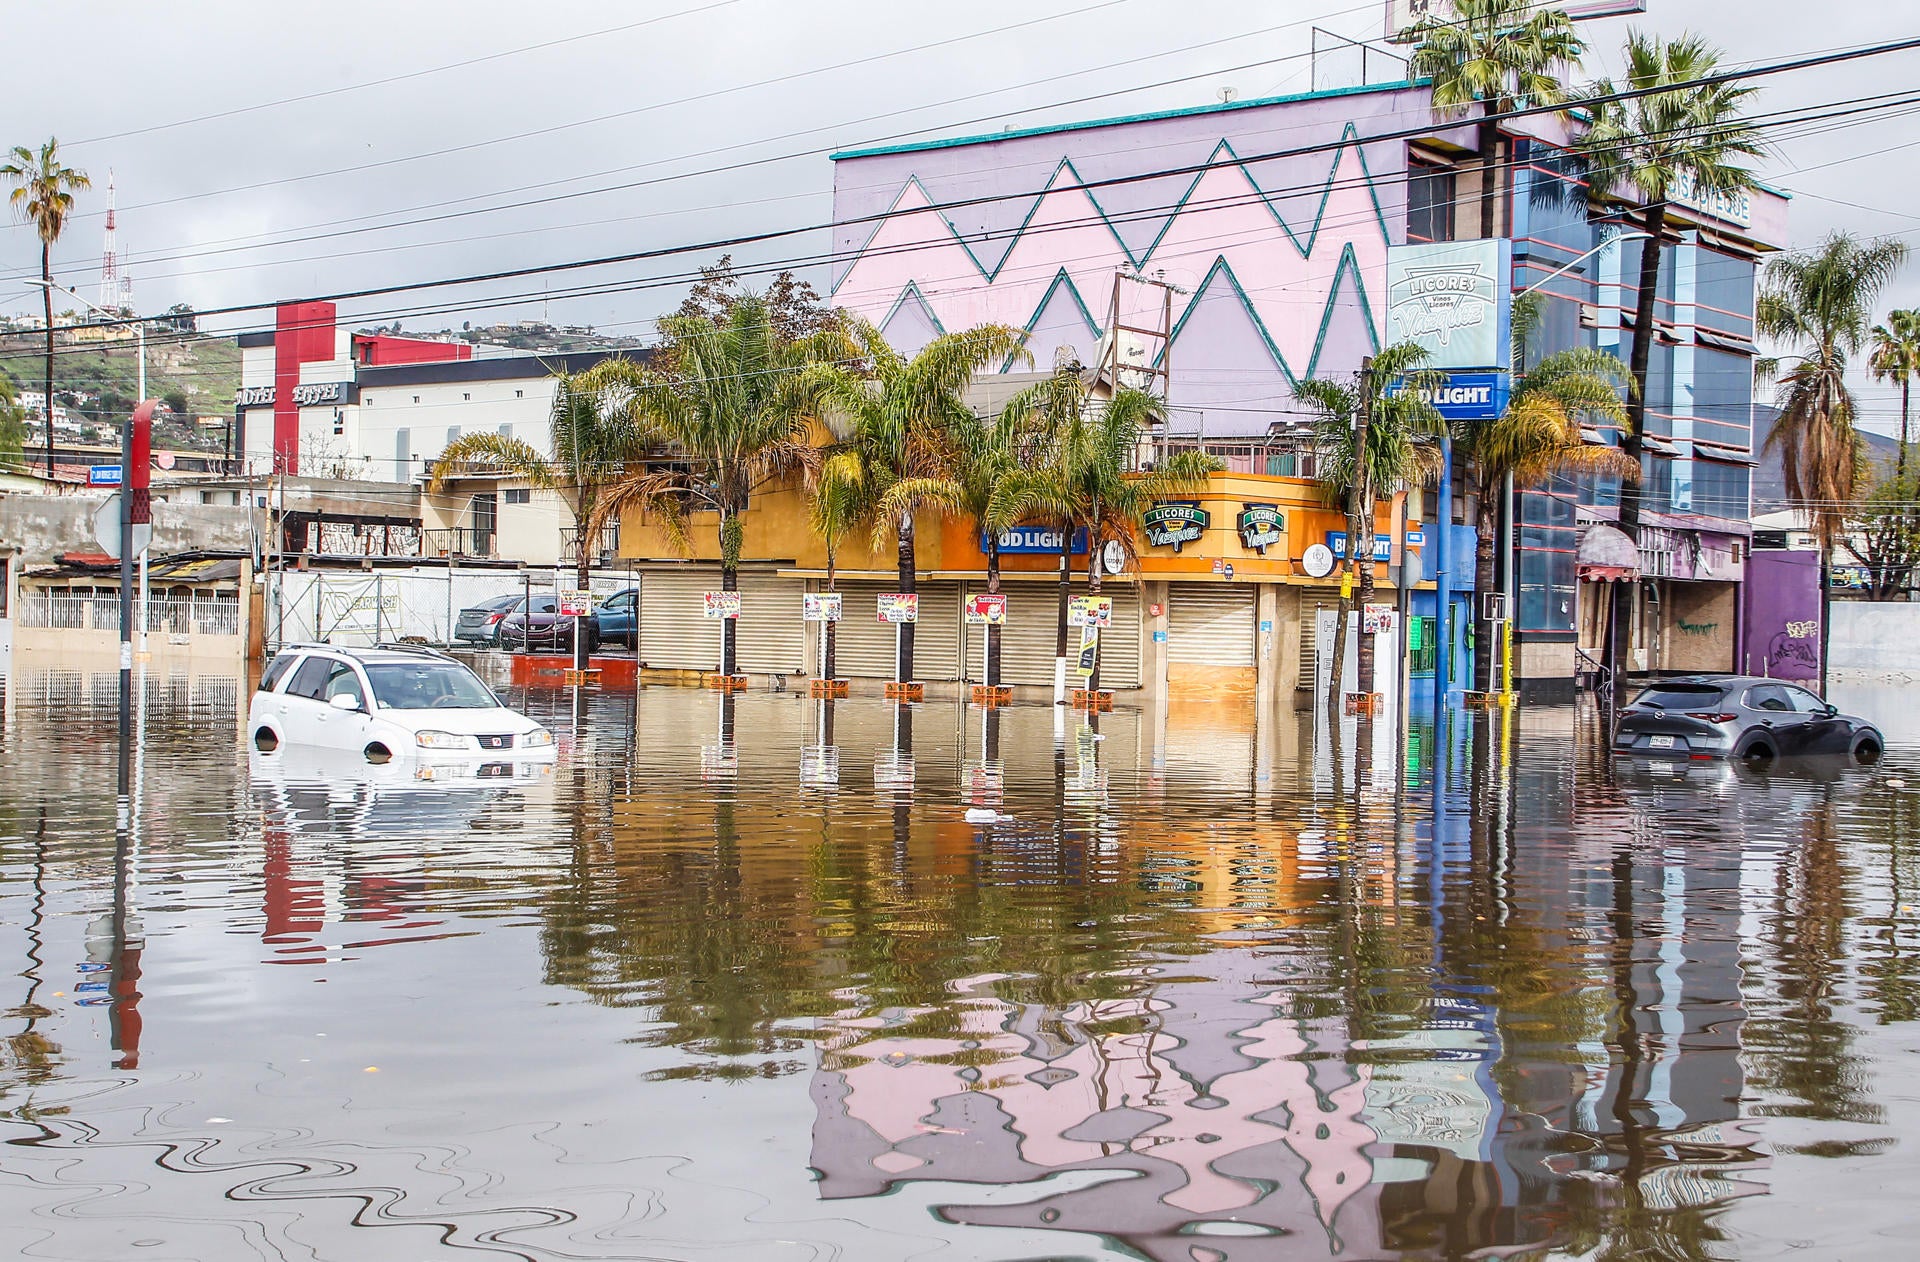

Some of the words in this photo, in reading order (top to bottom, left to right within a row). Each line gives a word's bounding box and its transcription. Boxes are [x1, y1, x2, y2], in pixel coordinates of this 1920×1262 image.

[1410, 276, 1477, 295] LICORES
[1432, 295, 1451, 303] Vinos
[1429, 301, 1454, 309] Licores
[234, 387, 277, 406] HOTEL
[1433, 387, 1490, 405] LIGHT
[1155, 509, 1195, 520] LICORES
[1250, 511, 1277, 522] LICORES
[311, 523, 355, 533] UPOLSTER
[998, 532, 1023, 547] UD
[1025, 532, 1075, 548] LIGH
